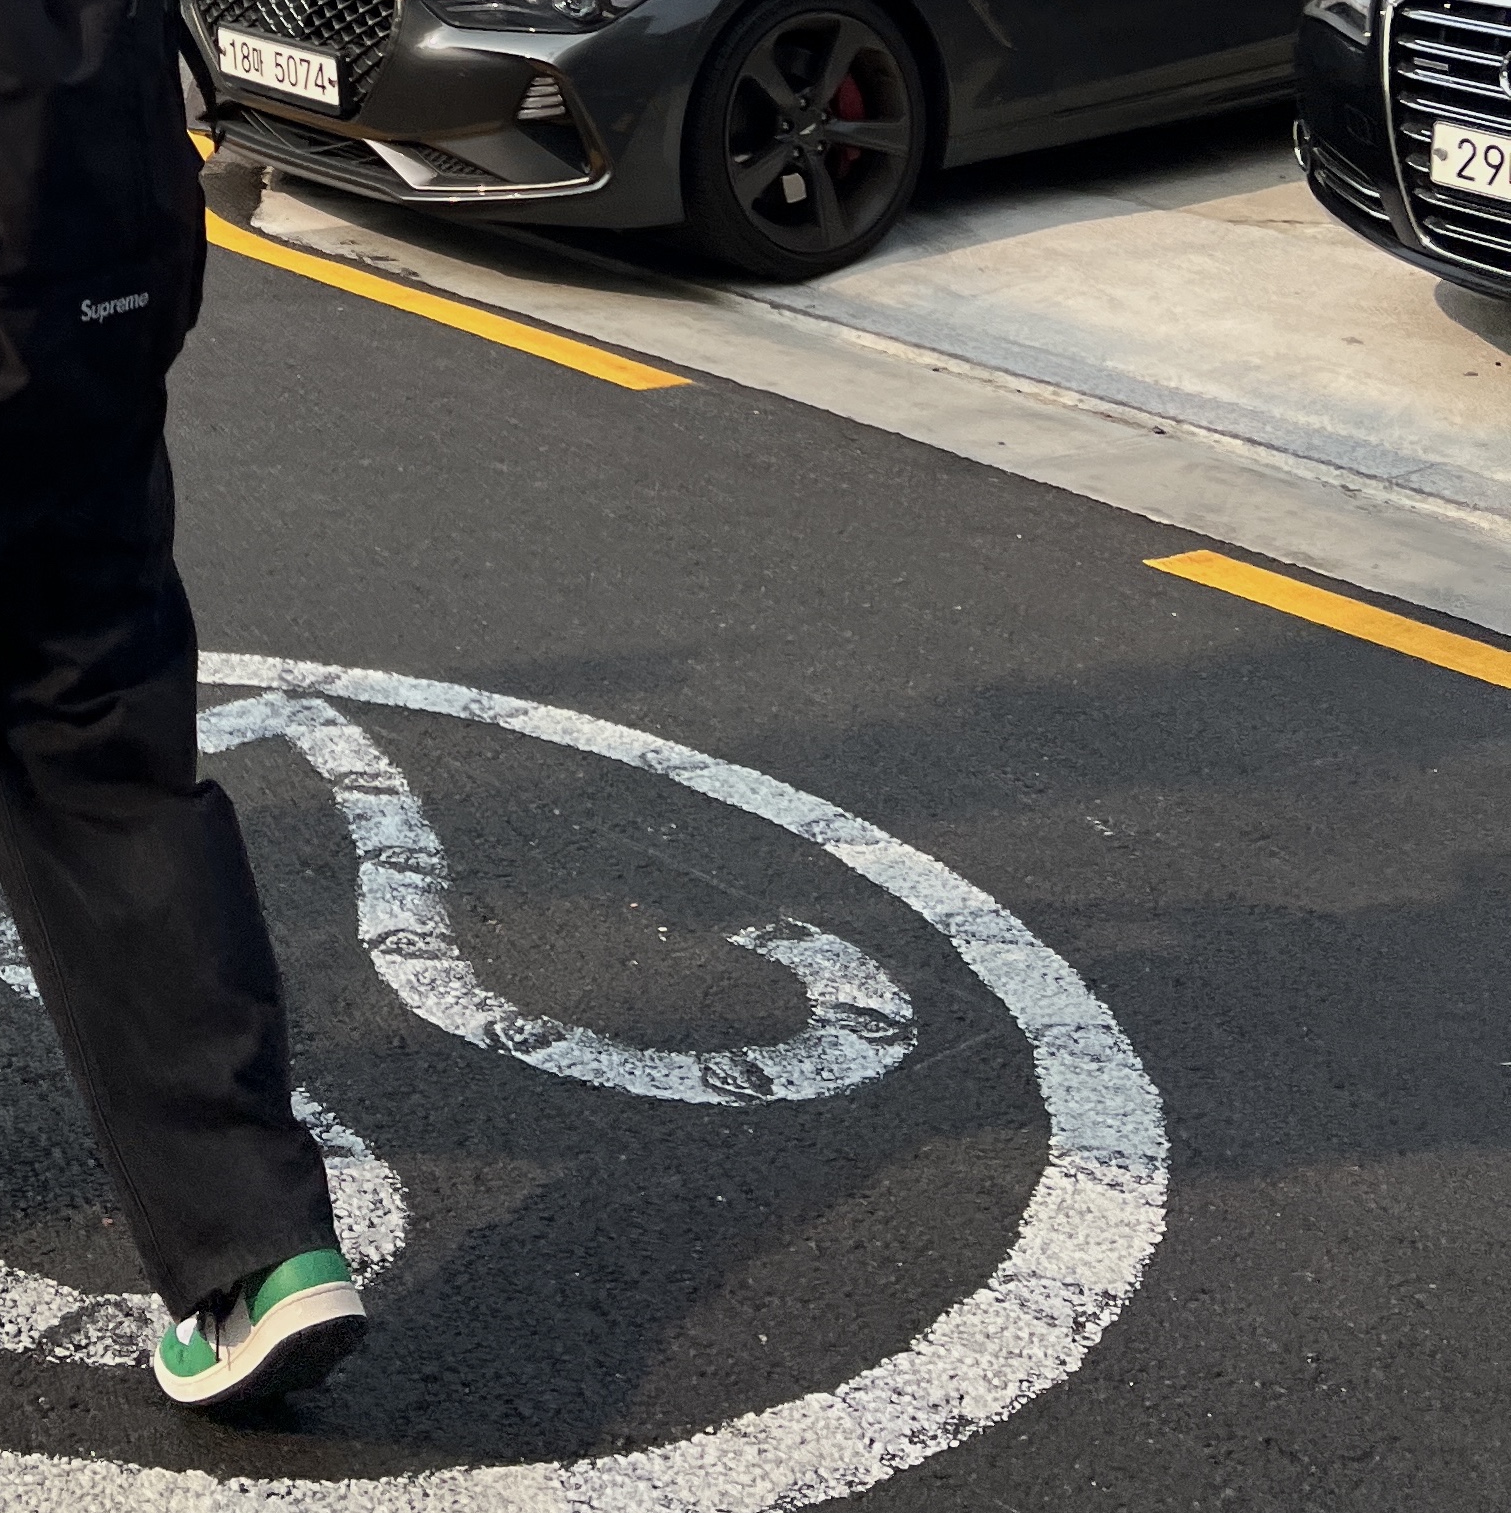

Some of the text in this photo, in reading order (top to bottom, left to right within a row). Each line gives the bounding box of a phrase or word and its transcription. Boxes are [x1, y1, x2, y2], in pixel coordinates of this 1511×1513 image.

[229, 39, 326, 96] 18마 5074
[80, 291, 150, 324] Supreme
